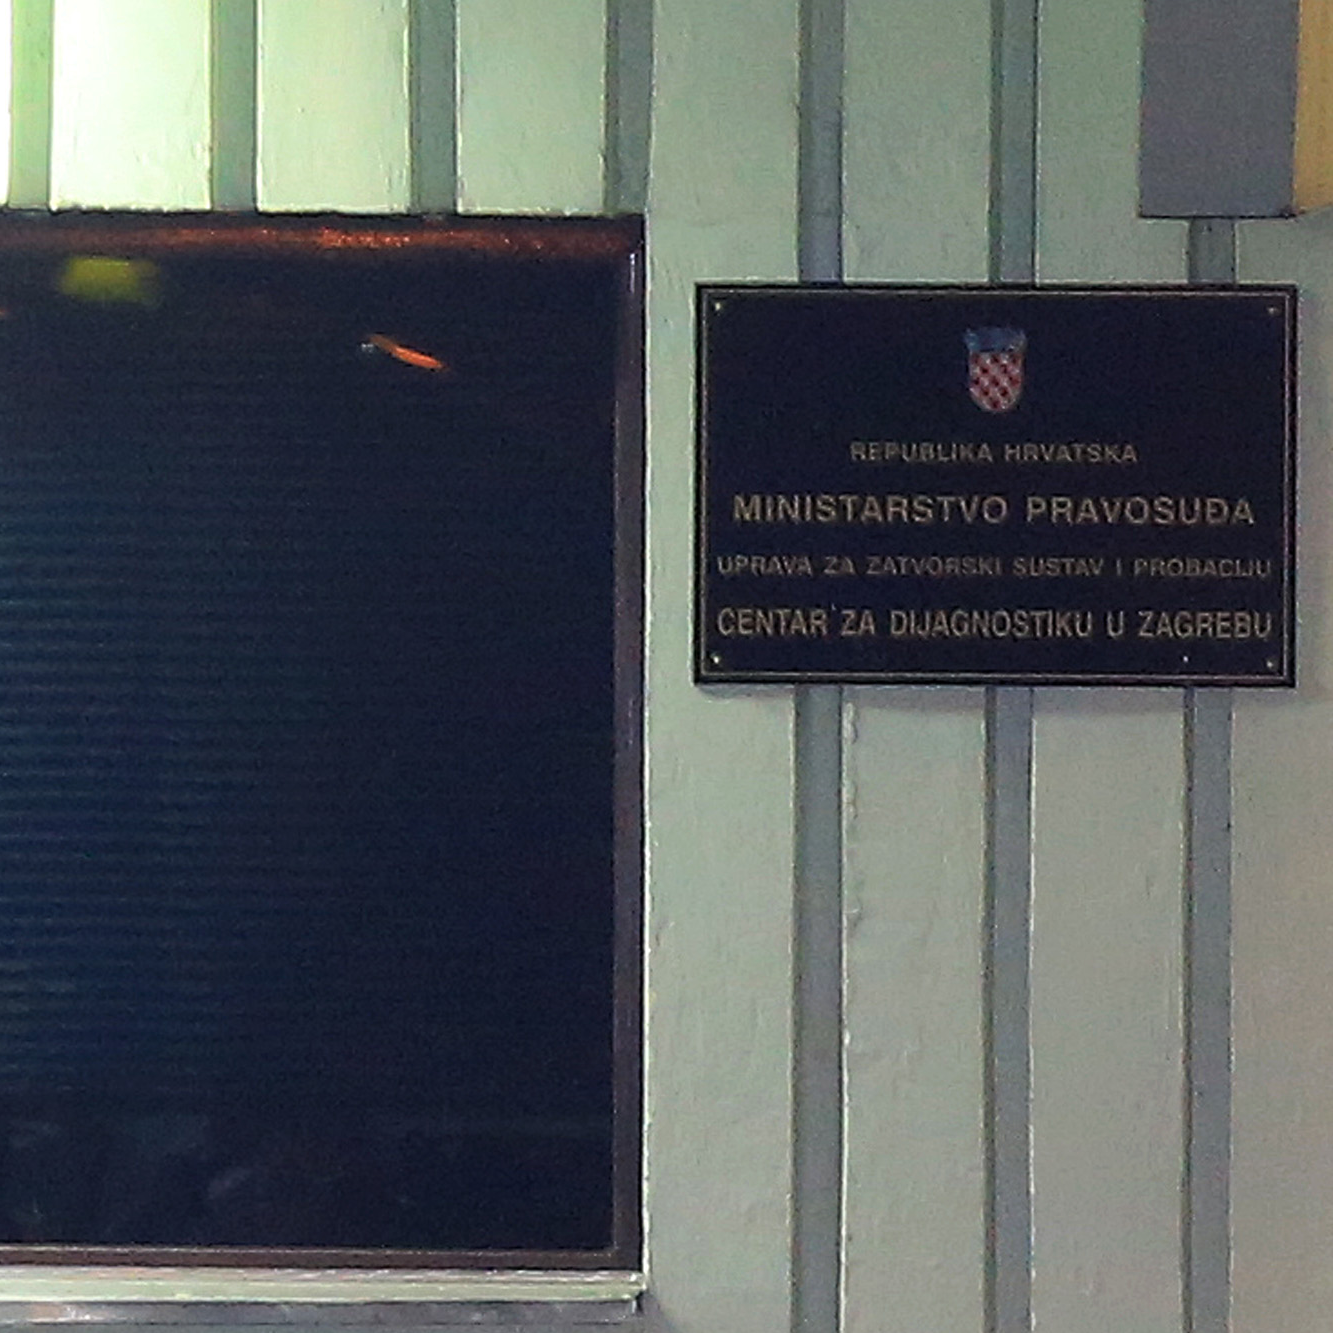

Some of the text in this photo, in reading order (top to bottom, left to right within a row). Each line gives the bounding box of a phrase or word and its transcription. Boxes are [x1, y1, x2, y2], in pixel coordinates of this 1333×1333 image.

[850, 442, 1138, 463] REPUBLIKA HRVATSKA
[734, 495, 1255, 525] MINISTARSTVO PRAVOSUĐA
[717, 555, 812, 576] UPRAVA
[824, 556, 855, 576] ZA
[866, 556, 1002, 576] ZATVORSKI
[1013, 557, 1104, 577] SUSTAV
[1134, 558, 1271, 578] PROBACIJU
[717, 607, 1273, 639] CENTAR ZA DIJAGNOSTIKU U ZAGREBU
